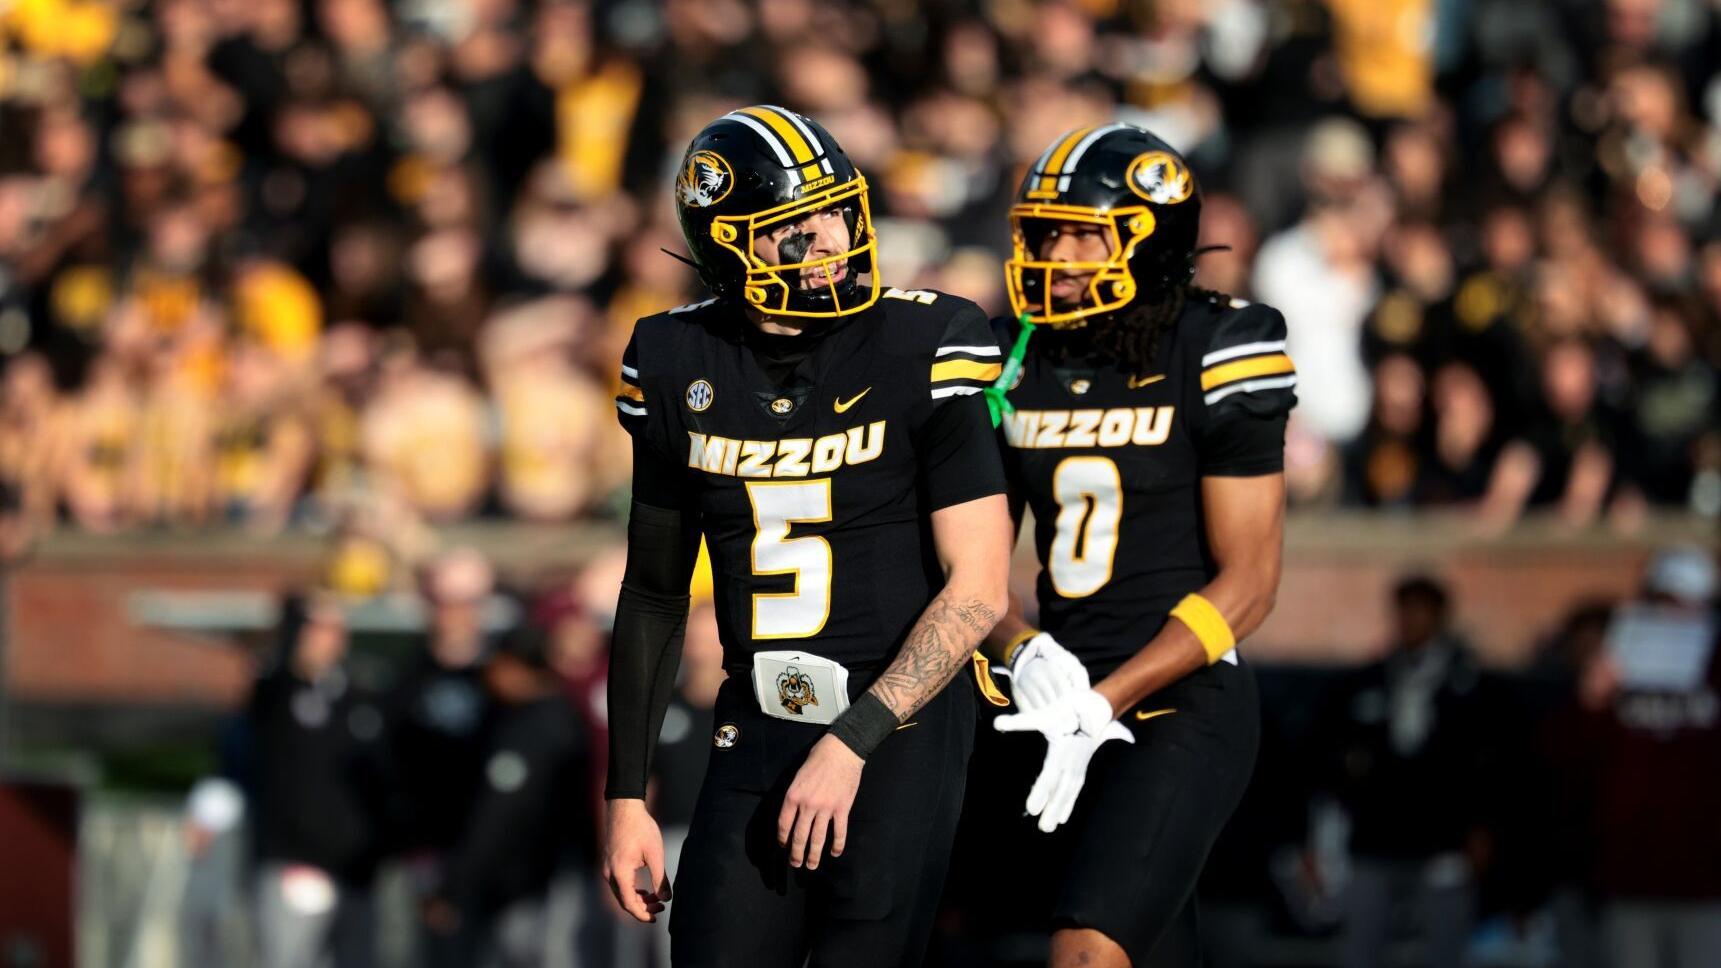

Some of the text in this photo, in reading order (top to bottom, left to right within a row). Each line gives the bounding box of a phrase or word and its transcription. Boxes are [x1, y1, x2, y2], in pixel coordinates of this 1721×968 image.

[800, 175, 835, 194] MIZZOU
[687, 381, 712, 409] SEC
[687, 420, 886, 478] MIZZOU
[1049, 455, 1123, 599] 0
[744, 477, 833, 640] 5
